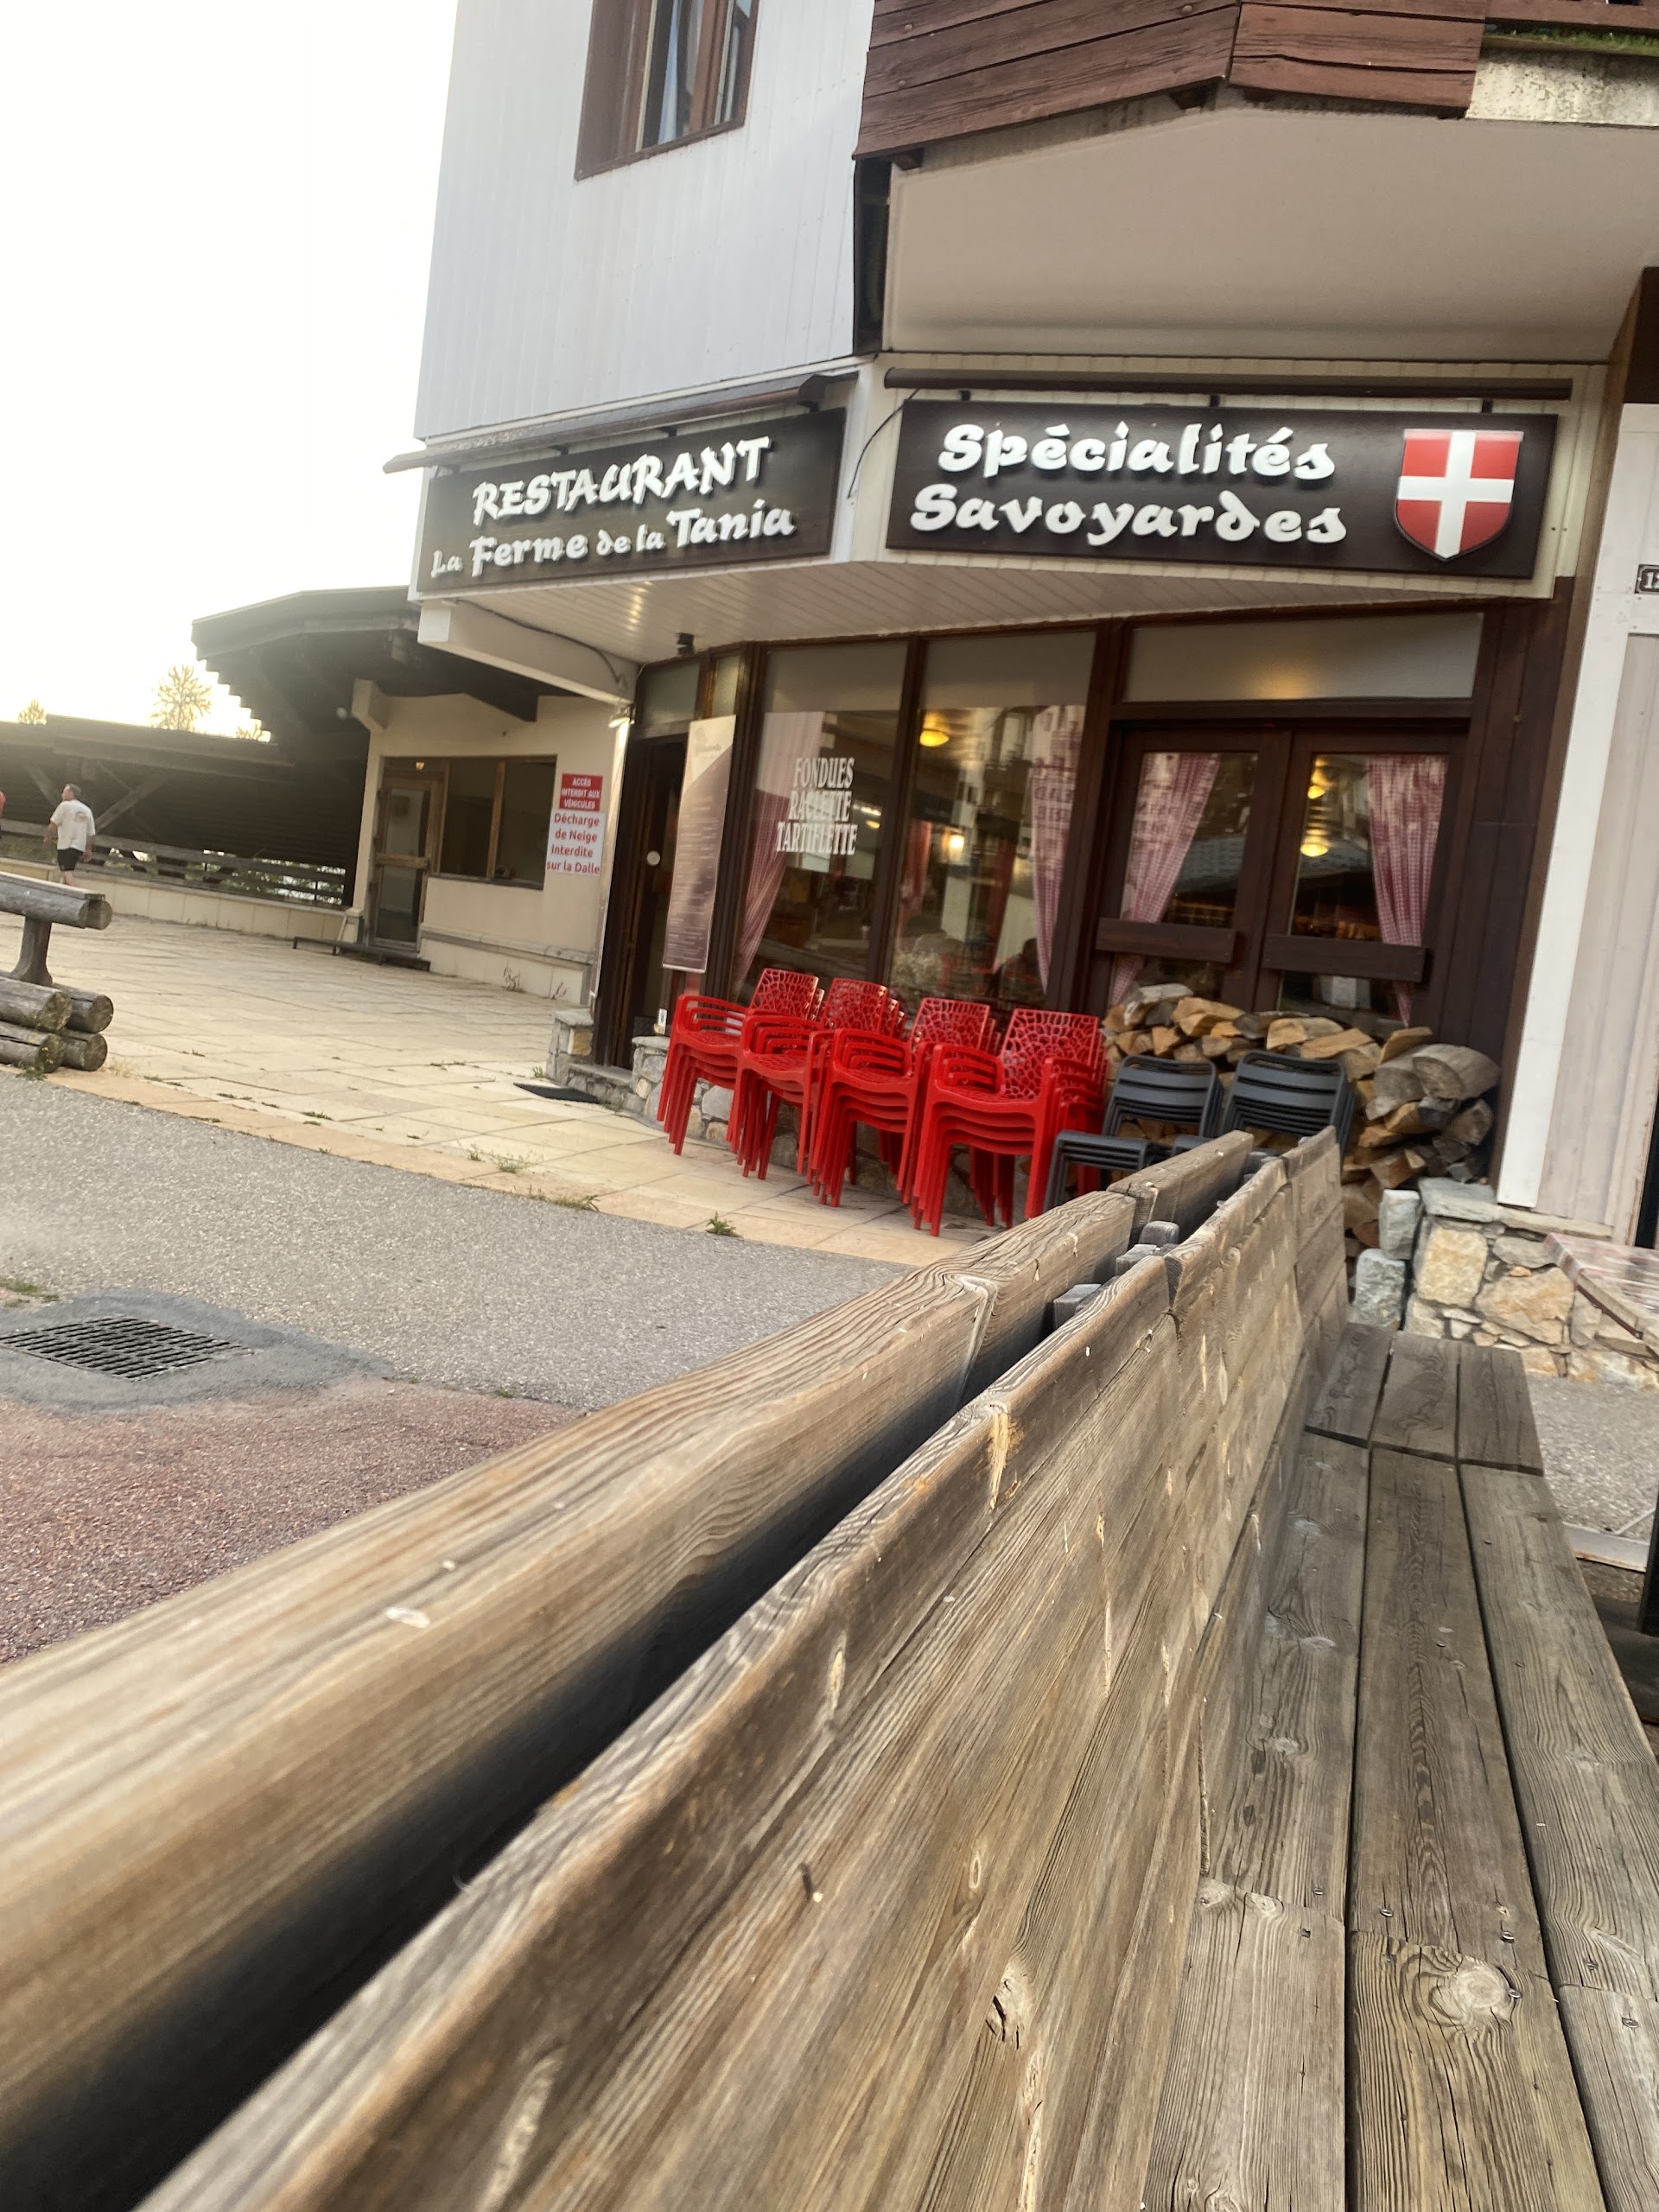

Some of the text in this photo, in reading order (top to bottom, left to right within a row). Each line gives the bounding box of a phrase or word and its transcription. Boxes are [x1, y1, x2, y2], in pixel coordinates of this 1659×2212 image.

[938, 422, 1336, 480] Spécialités
[472, 435, 772, 525] RESTAURANT
[910, 483, 1347, 545] Savoyardes
[431, 499, 797, 578] La Ferme de la Tania
[793, 758, 855, 788] FONDUES
[562, 788, 601, 798] INTERDIT AUX
[788, 790, 852, 822] RACLETTE
[554, 813, 600, 829] Décharge
[555, 829, 597, 844] de Neige
[551, 844, 593, 857] Interdite
[776, 821, 858, 855] TARTIFLETTE
[547, 861, 600, 874] sur la Dalle
